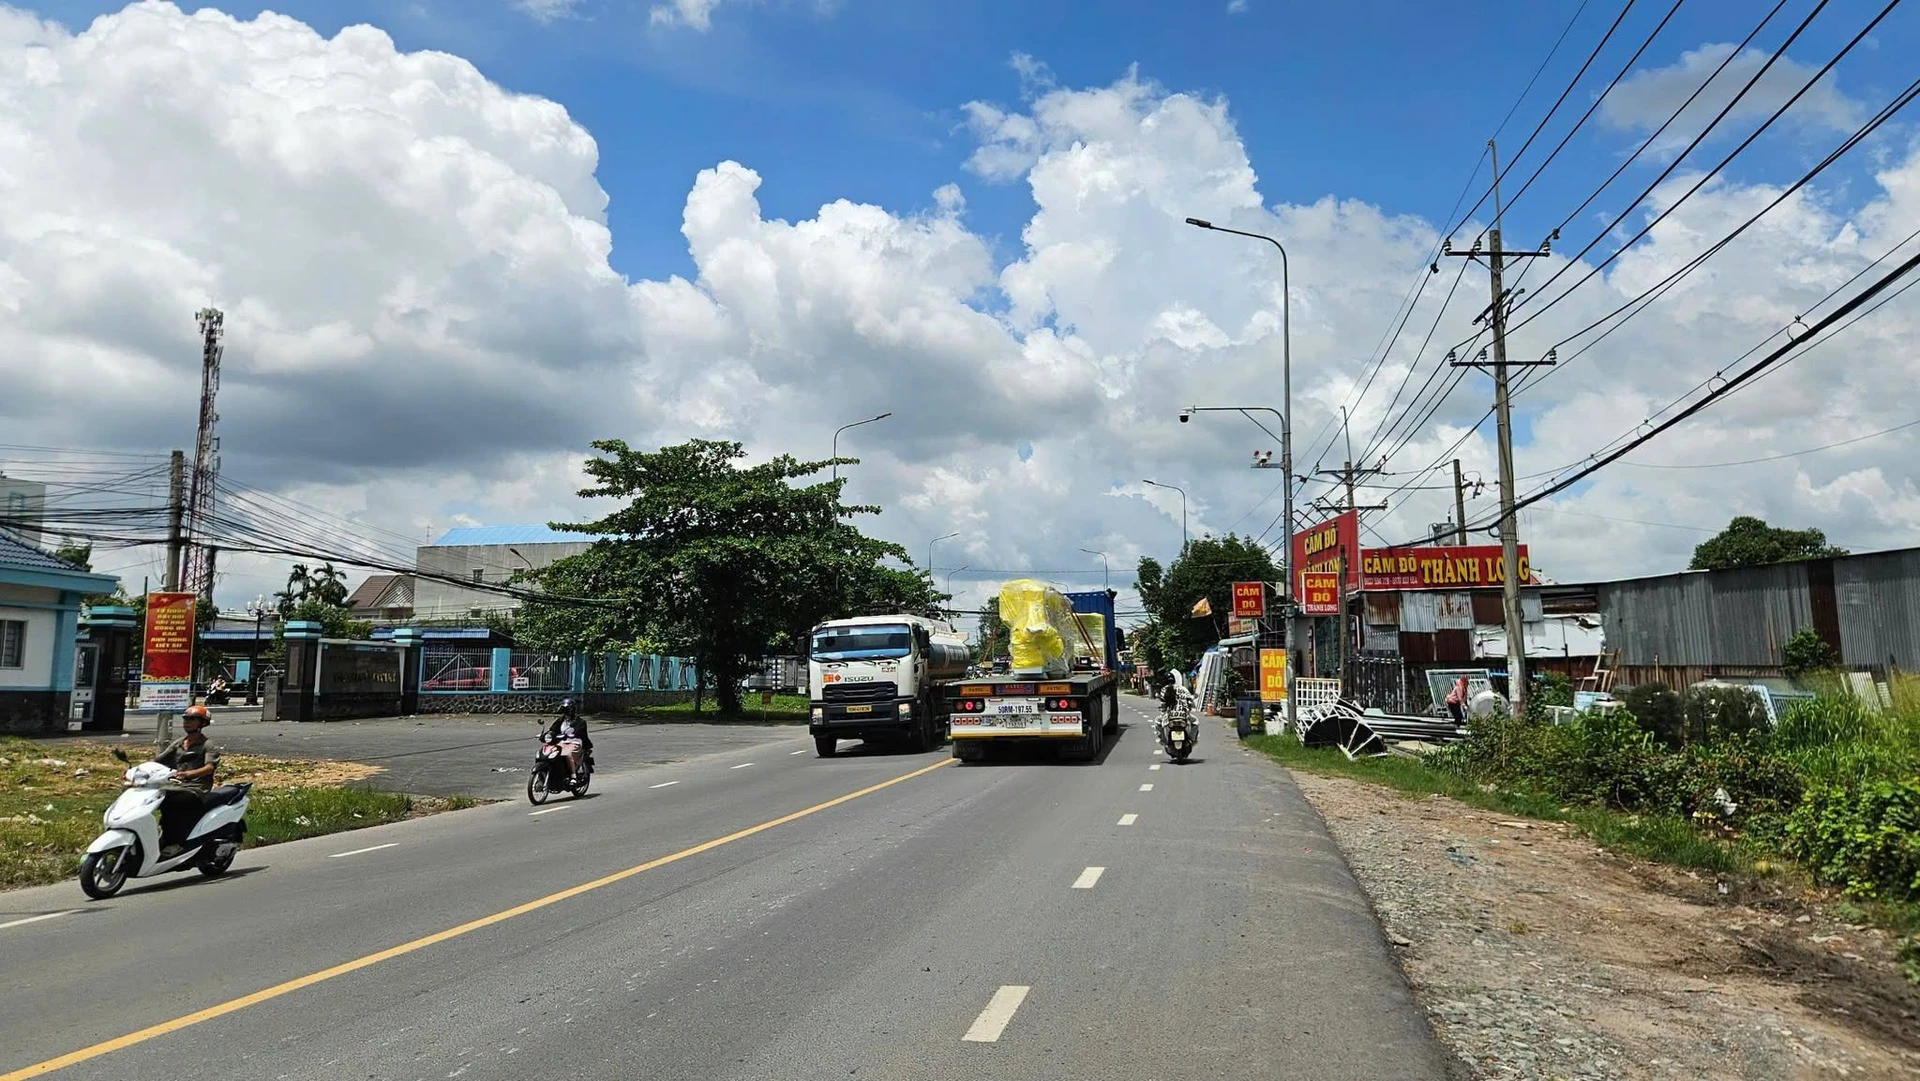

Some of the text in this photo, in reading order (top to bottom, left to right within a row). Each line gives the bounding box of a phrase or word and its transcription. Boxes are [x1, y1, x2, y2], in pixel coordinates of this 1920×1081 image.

[1304, 520, 1337, 555] CẦM ĐỒ
[1364, 551, 1530, 584] CẦM ĐỒ THÀNH LOG
[1306, 575, 1336, 588] CẦM
[1307, 602, 1337, 612] THÀNH LONG
[998, 705, 1033, 714] 50RM-197.55
